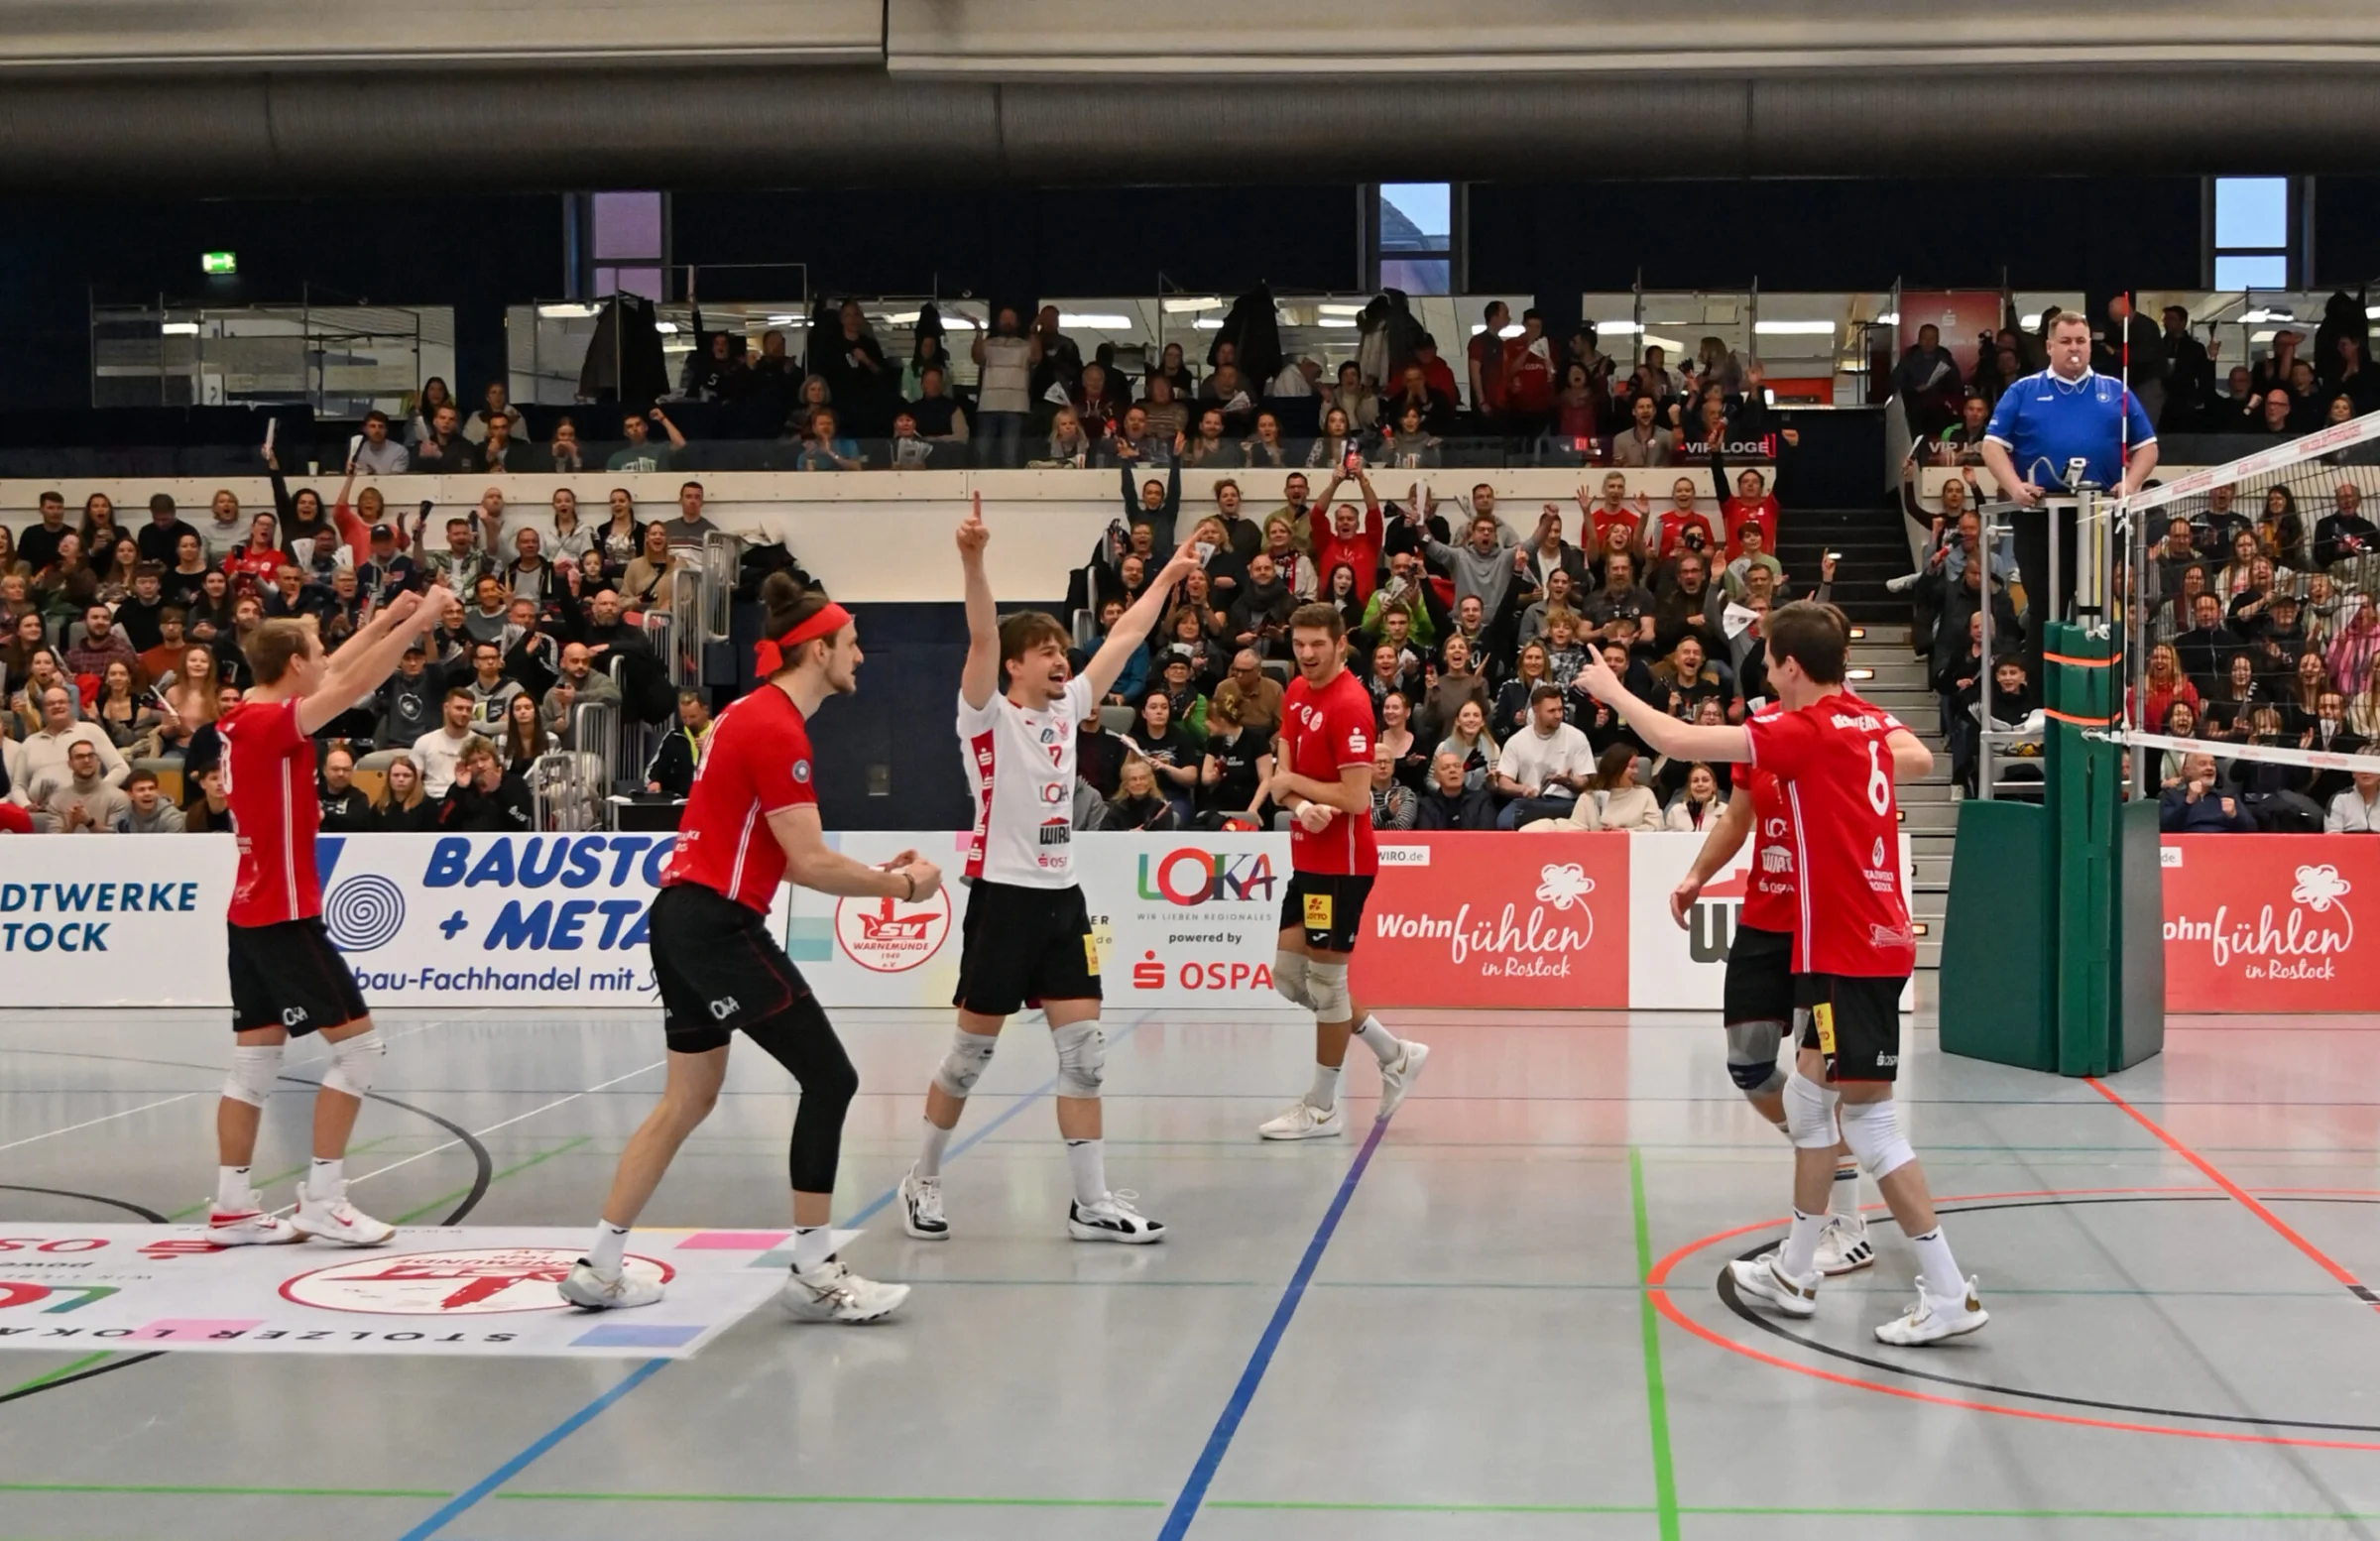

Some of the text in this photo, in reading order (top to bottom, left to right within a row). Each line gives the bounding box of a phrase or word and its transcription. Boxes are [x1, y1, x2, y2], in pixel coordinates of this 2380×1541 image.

[1721, 441, 1769, 453] LOGE
[1929, 441, 1958, 453] VIP
[1048, 745, 1062, 769] 7
[1867, 740, 1890, 816] 6
[1137, 847, 1278, 906] LOKA
[0, 882, 199, 912] DTWERKE
[2, 922, 111, 952] TOCK
[1169, 932, 1242, 945] powered by
[1376, 903, 1590, 965] Wohnfühlen
[589, 967, 635, 991] mit
[1180, 962, 1275, 990] OSPA
[1482, 956, 1571, 979] in Rostock
[2246, 958, 2335, 981] in Rostock
[208, 1330, 519, 1343] STOLZER
